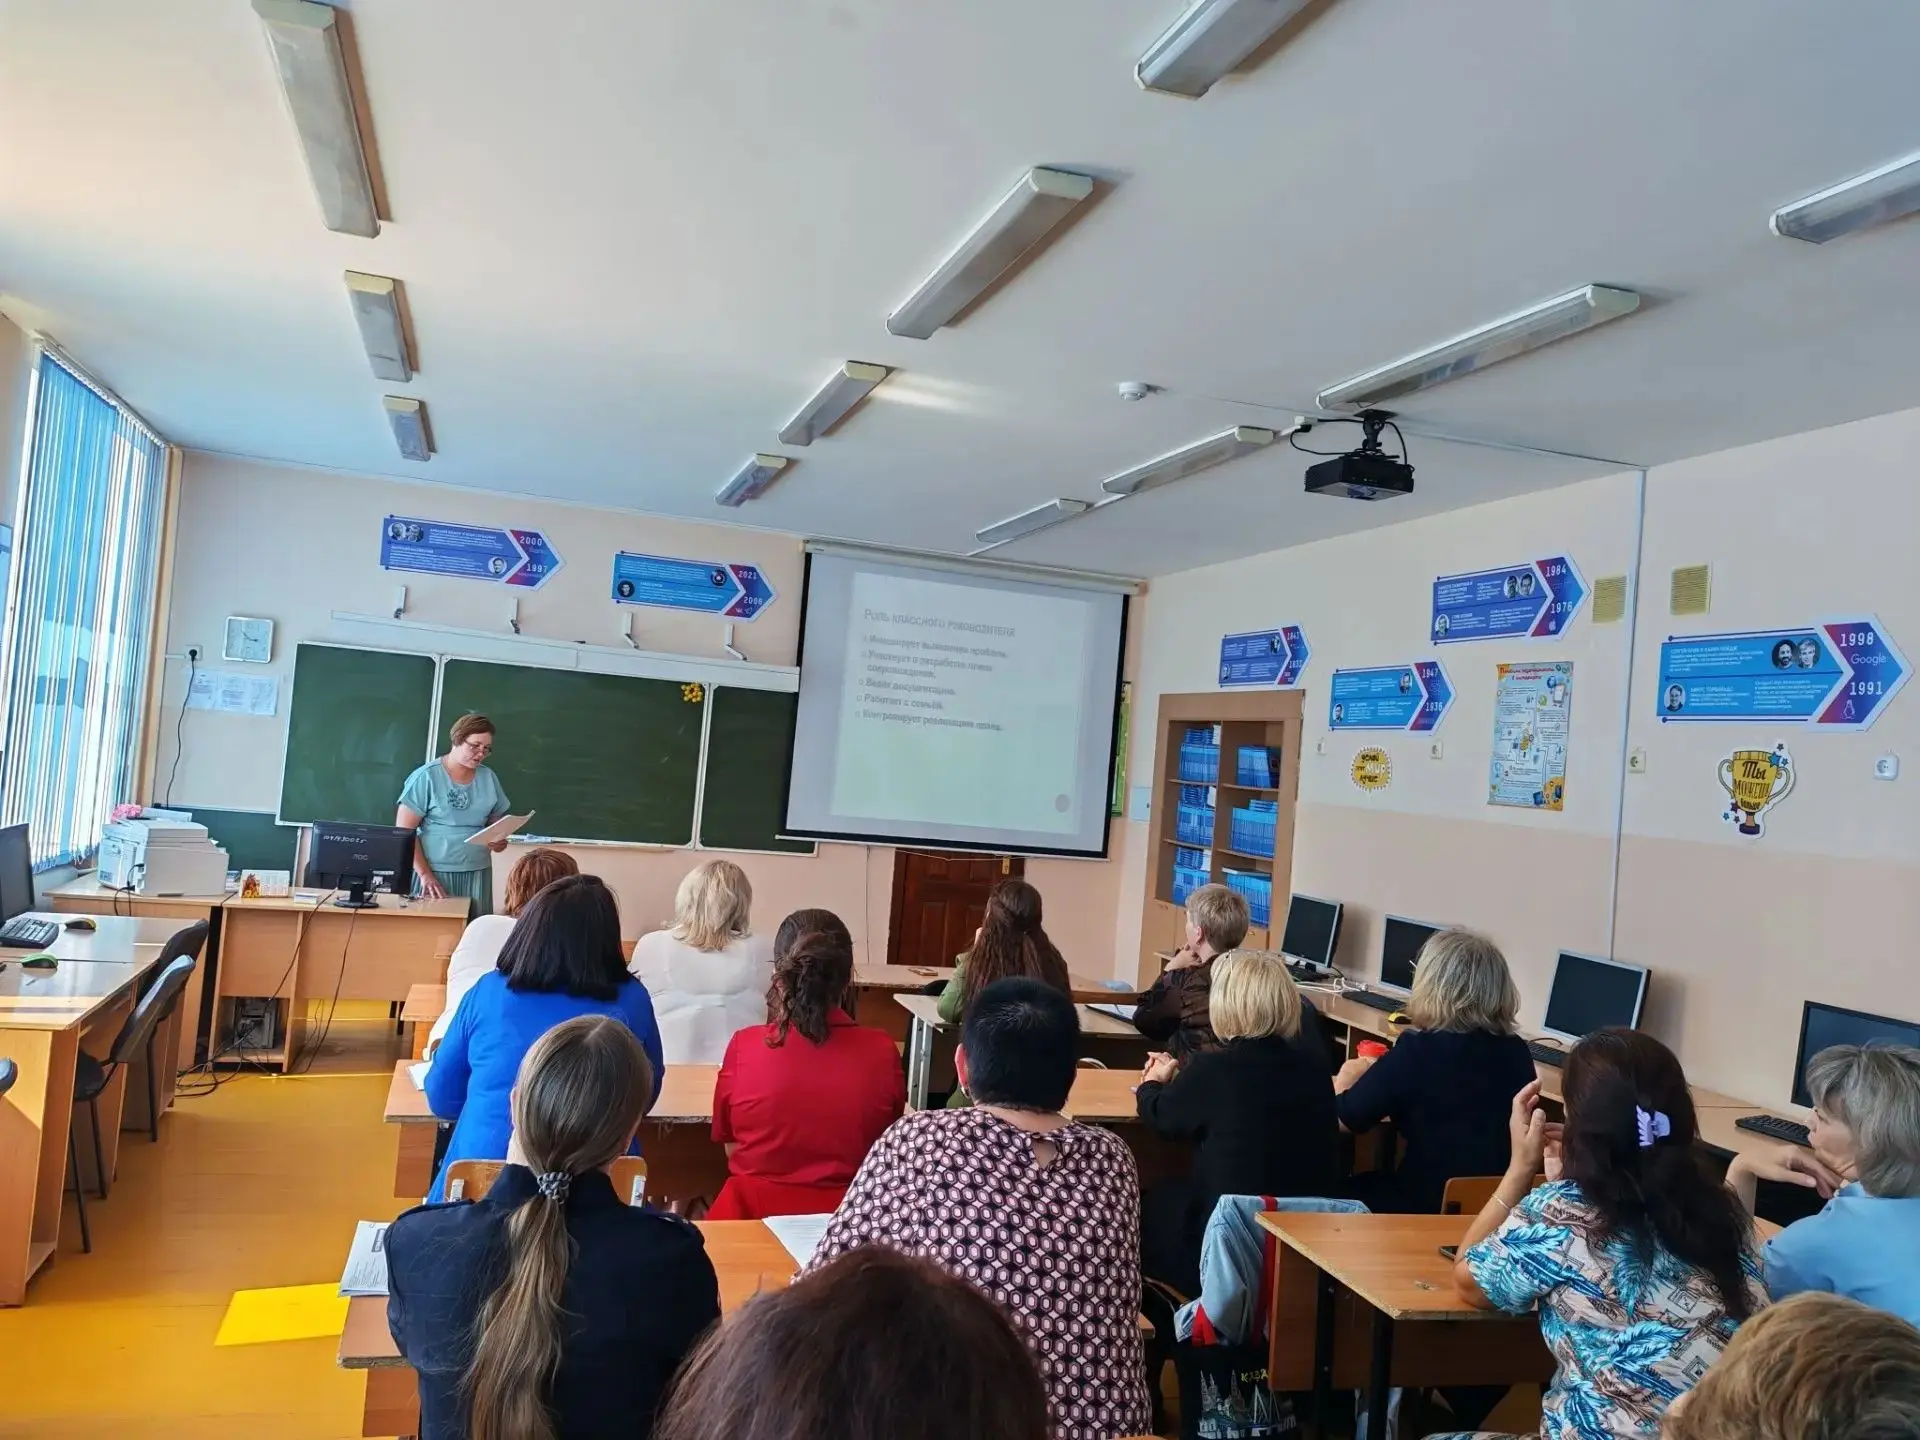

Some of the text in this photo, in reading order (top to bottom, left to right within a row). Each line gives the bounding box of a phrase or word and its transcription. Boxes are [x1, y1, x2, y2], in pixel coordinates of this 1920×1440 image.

[520, 536, 543, 546] 2000
[527, 563, 548, 573] 1997
[1546, 564, 1567, 577] 1984
[1551, 601, 1573, 614] 1976
[1840, 632, 1874, 647] 1998
[1851, 653, 1887, 667] Google
[1849, 681, 1883, 696] 1991
[1742, 761, 1767, 780] Ты
